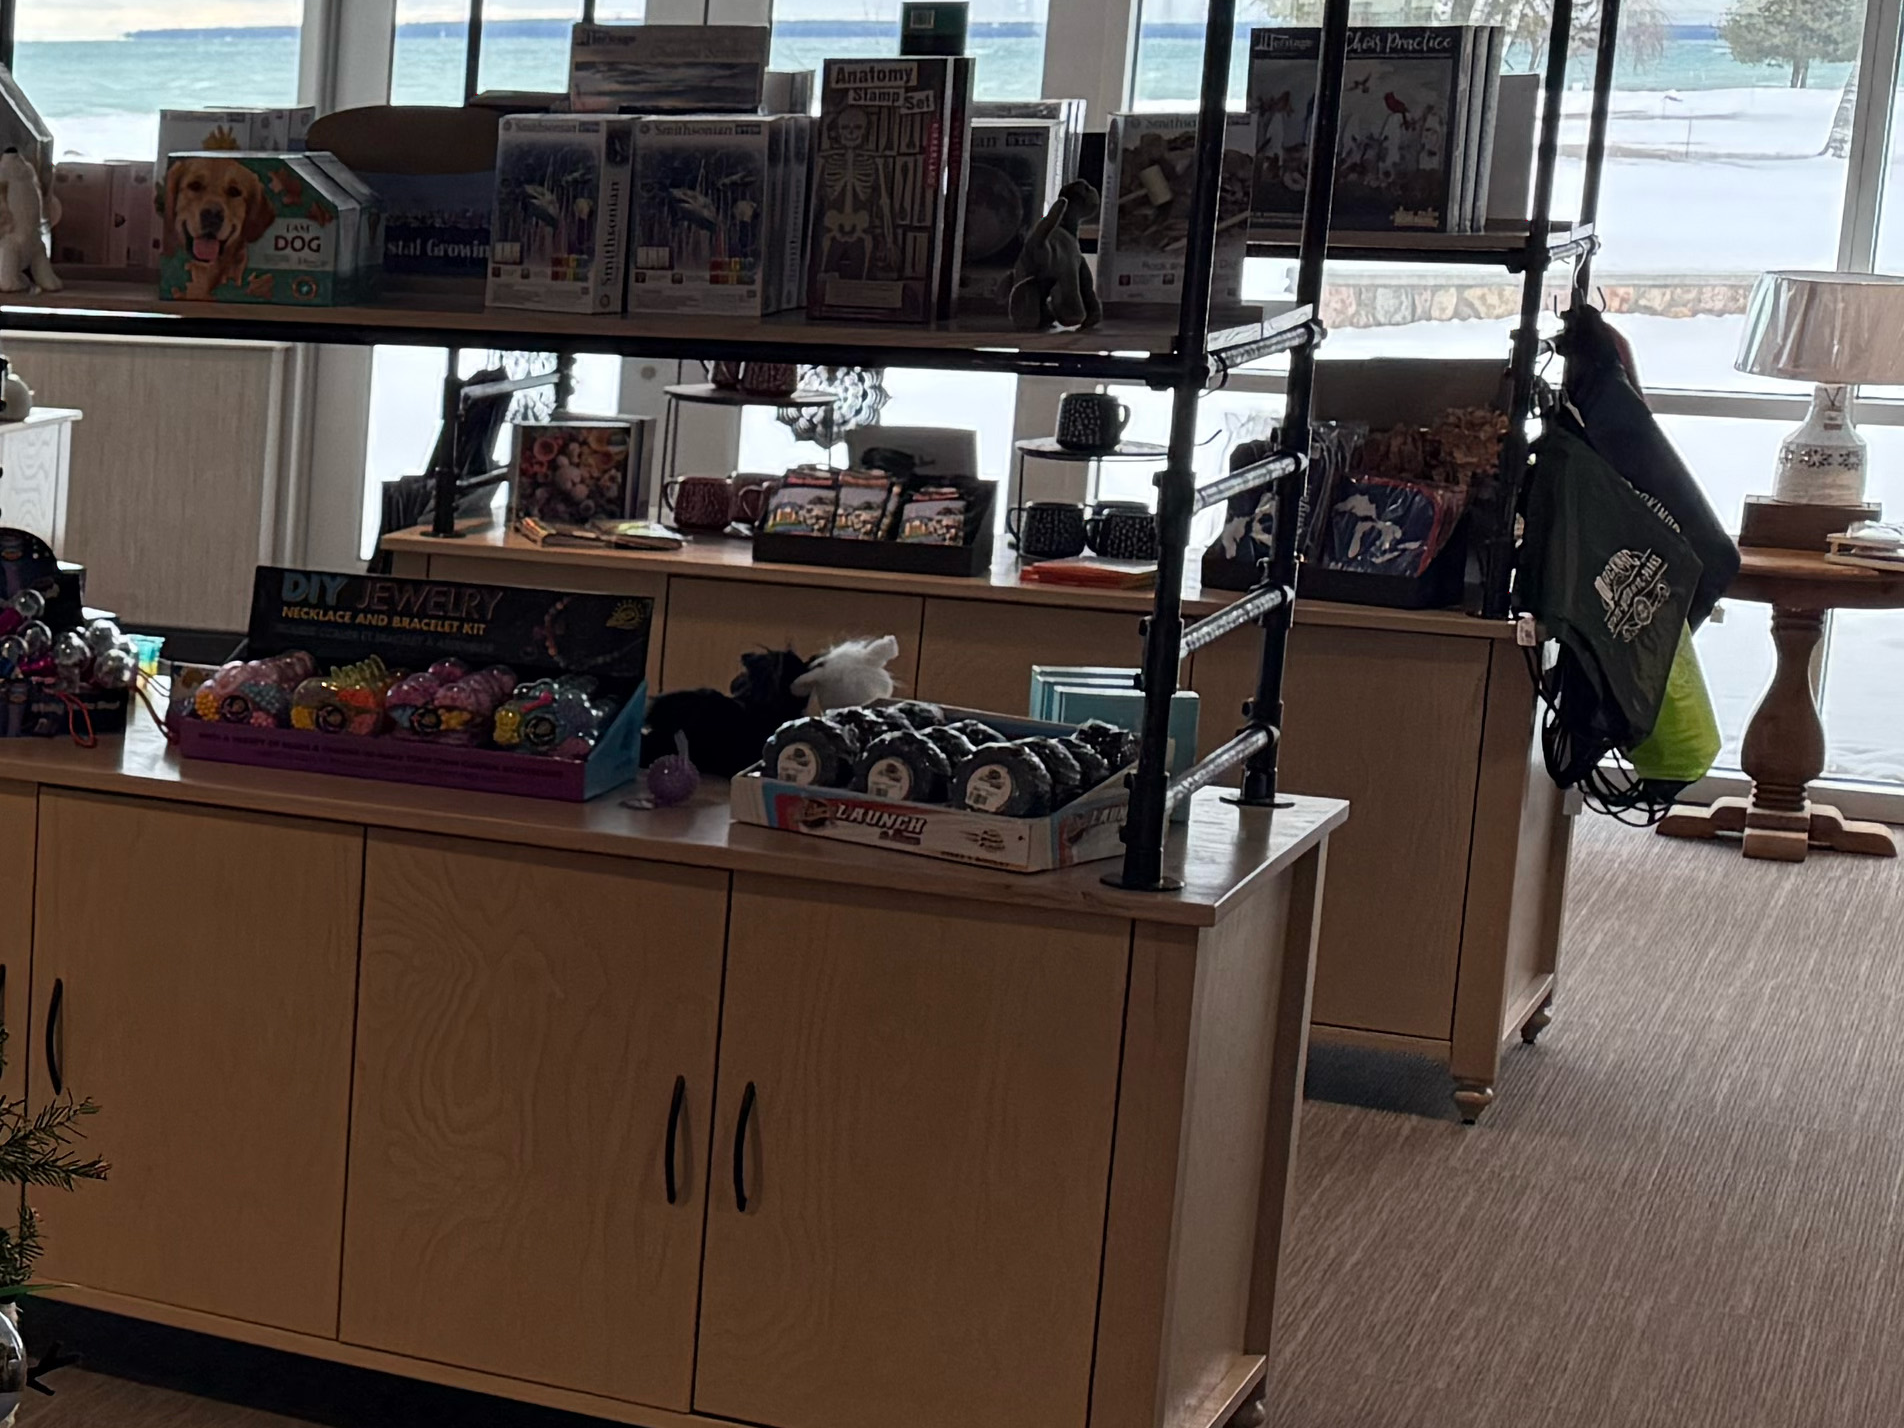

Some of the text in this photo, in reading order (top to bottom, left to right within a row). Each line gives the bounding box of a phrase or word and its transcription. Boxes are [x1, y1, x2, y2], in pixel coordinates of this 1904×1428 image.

[1346, 31, 1452, 53] Choir Practice
[835, 66, 913, 85] Anatomy
[852, 89, 931, 111] Stamp Set
[655, 123, 733, 135] Smithsonian
[274, 235, 322, 253] DOG
[601, 181, 620, 286] Smithsonian
[386, 238, 491, 259] stal Growin
[281, 572, 504, 620] DIY JEWELRY
[282, 606, 487, 636] NECKLACE AND BRACELET KIT
[836, 804, 927, 834] LAUNCH
